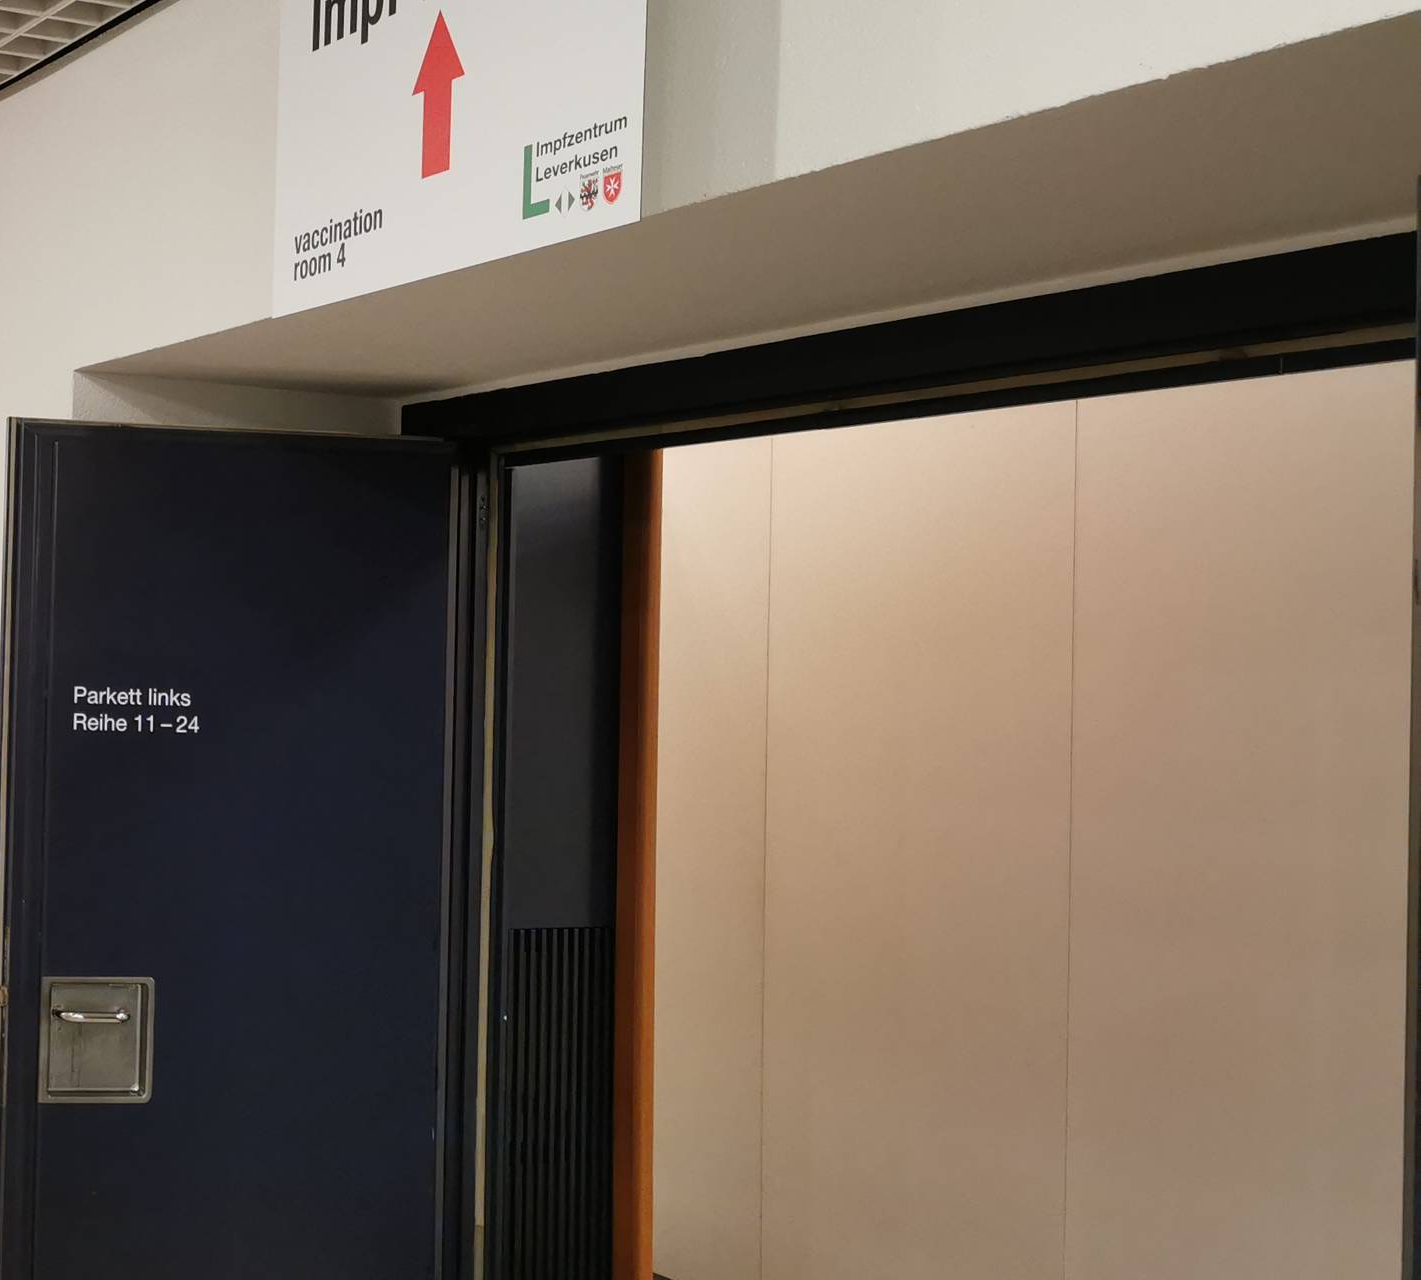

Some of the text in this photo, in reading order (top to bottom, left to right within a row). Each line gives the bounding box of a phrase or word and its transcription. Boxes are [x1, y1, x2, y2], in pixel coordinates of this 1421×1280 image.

[312, 0, 397, 52] Imp
[536, 116, 628, 157] Impfzentrum
[535, 145, 618, 182] Leverkusen
[294, 208, 383, 254] vaccination
[293, 242, 346, 281] room 4
[73, 685, 191, 707] Parkett links
[73, 712, 128, 732] Reihe
